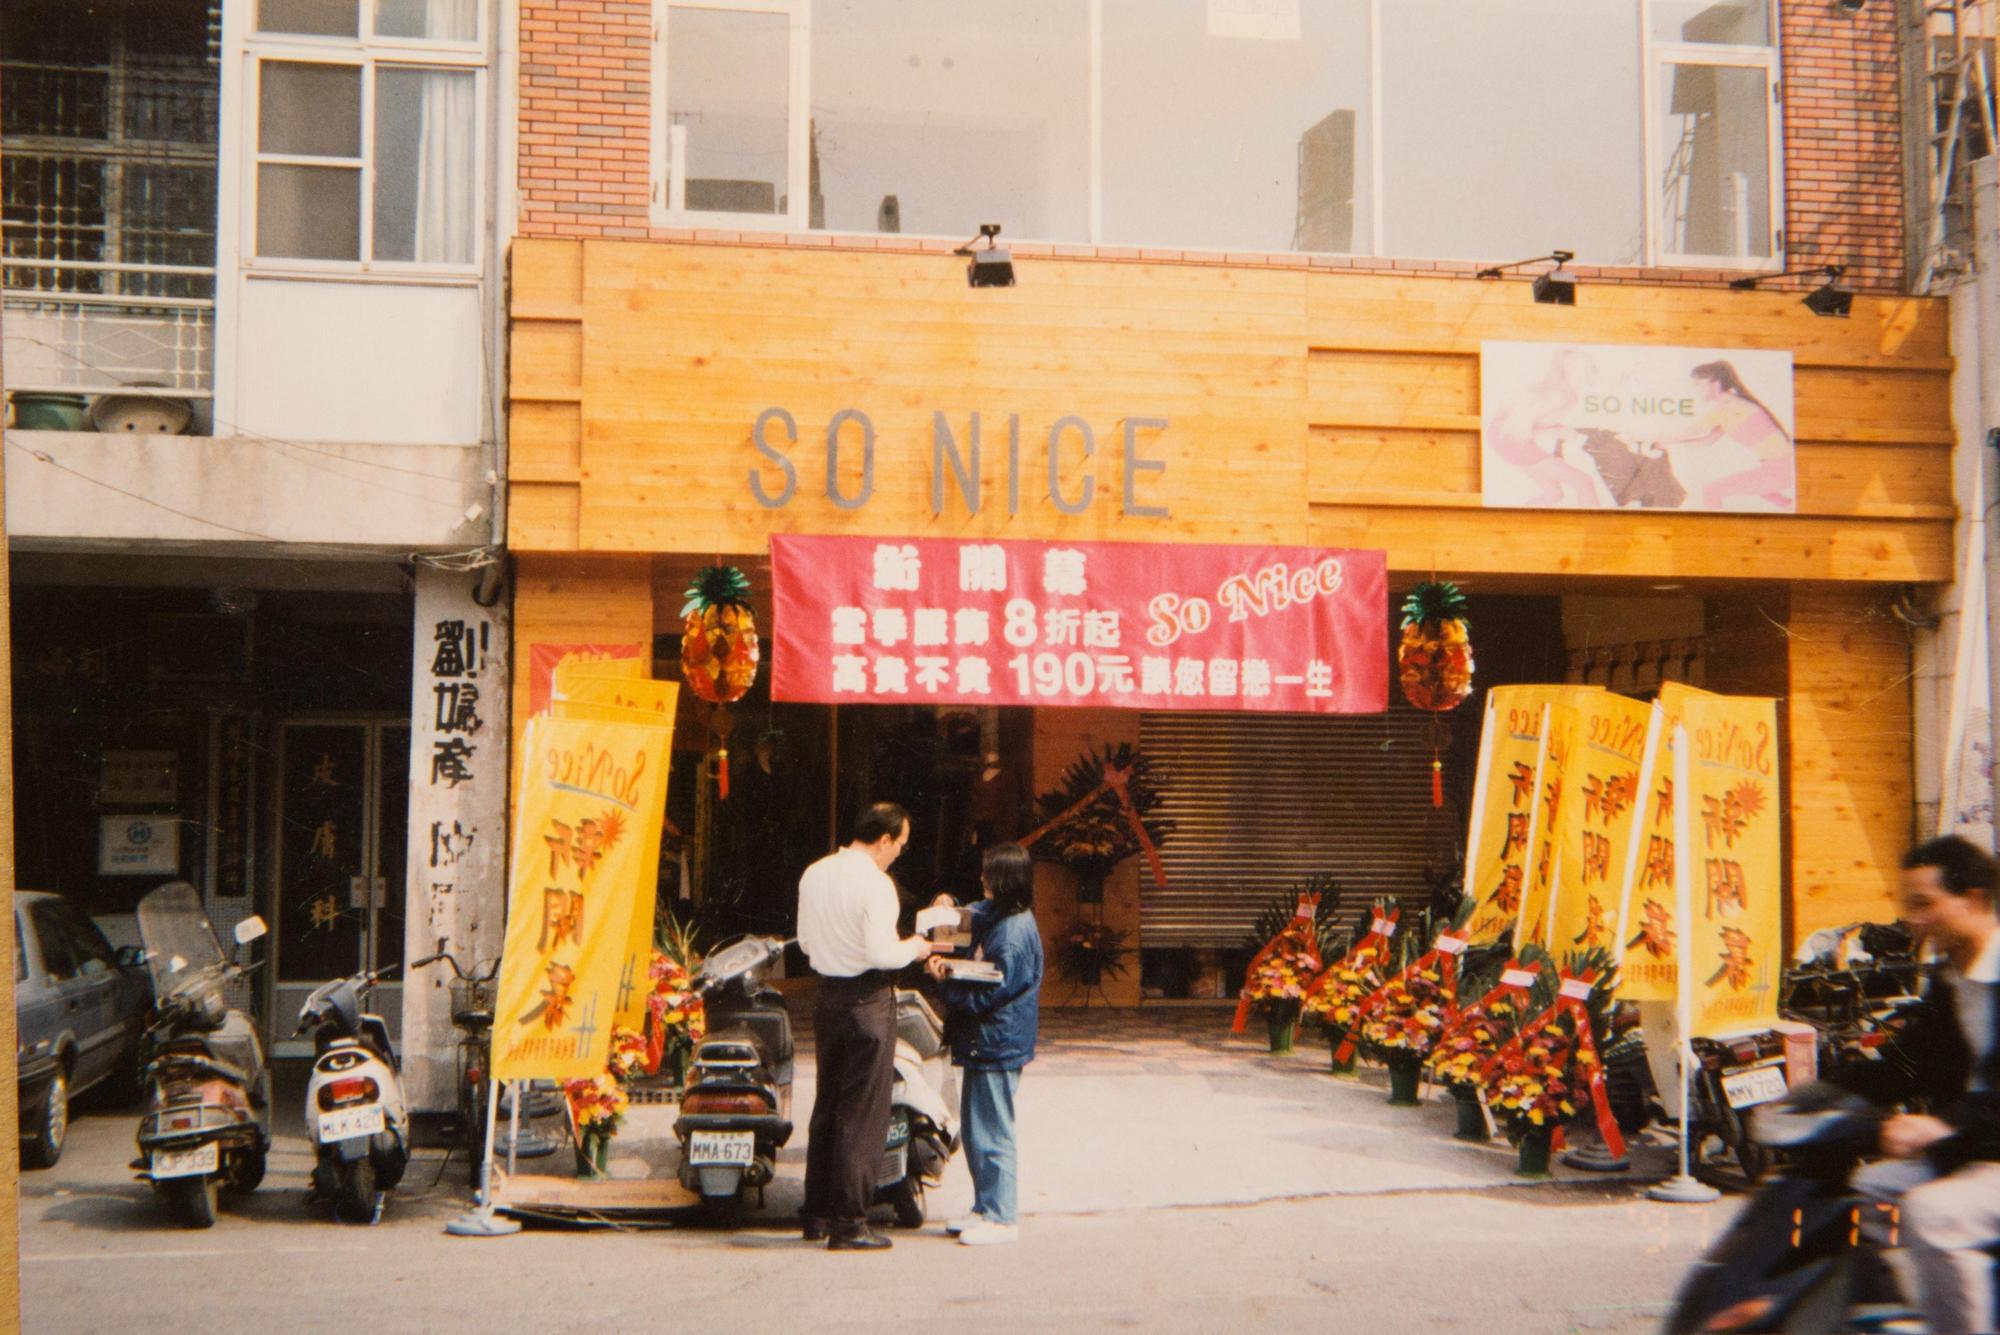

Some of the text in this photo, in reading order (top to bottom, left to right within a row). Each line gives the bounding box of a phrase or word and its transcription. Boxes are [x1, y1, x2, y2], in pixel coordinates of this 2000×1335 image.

[1583, 394, 1695, 417] SO NICE
[747, 406, 1172, 519] SO NICE
[1146, 557, 1343, 647] So Nice
